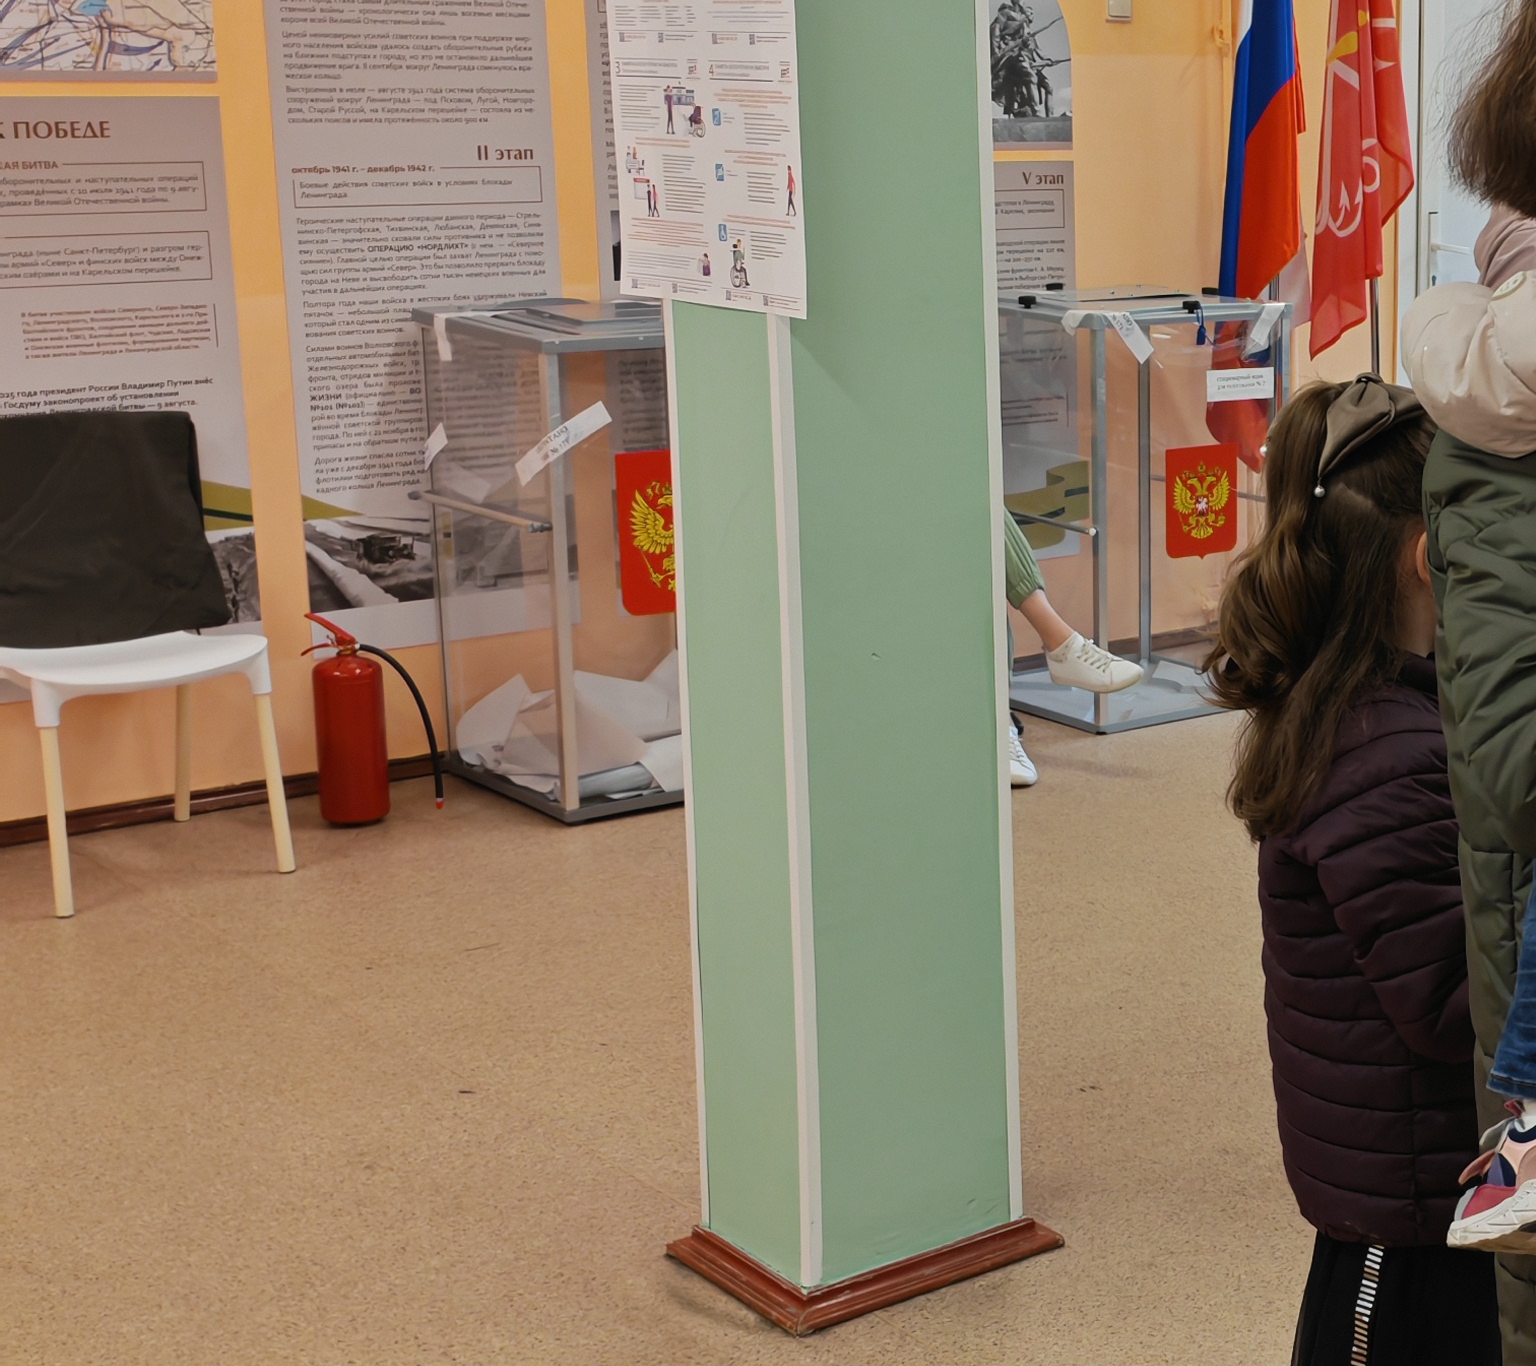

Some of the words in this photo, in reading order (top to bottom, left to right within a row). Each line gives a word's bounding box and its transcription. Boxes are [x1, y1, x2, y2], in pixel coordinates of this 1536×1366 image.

[13, 121, 111, 139] ПОБЕДЕ
[477, 145, 488, 161] II
[495, 147, 534, 161] этап
[22, 160, 59, 171] БИТВА
[1022, 171, 1032, 185] V
[1036, 174, 1064, 185] этап
